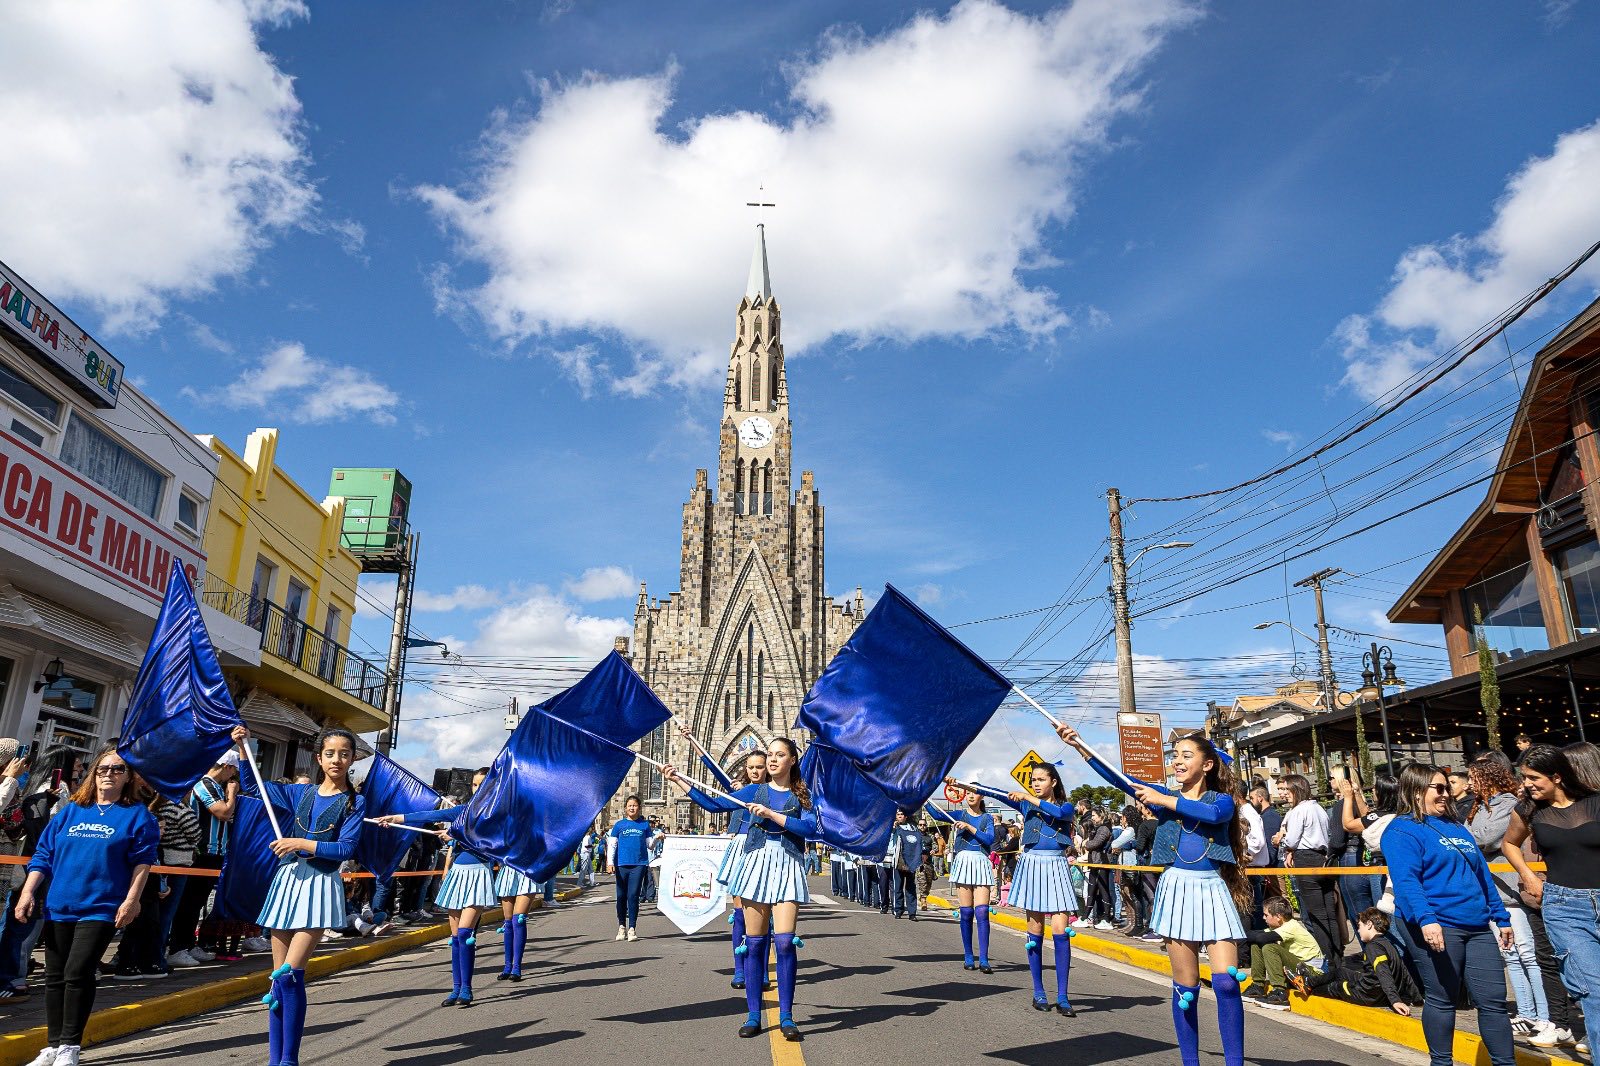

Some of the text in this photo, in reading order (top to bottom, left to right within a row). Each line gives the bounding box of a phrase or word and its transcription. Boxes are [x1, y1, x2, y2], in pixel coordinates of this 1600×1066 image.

[85, 351, 117, 396] SUL
[56, 490, 99, 556] DE
[100, 515, 198, 594] MALHS
[69, 822, 115, 835] CÔNEGO
